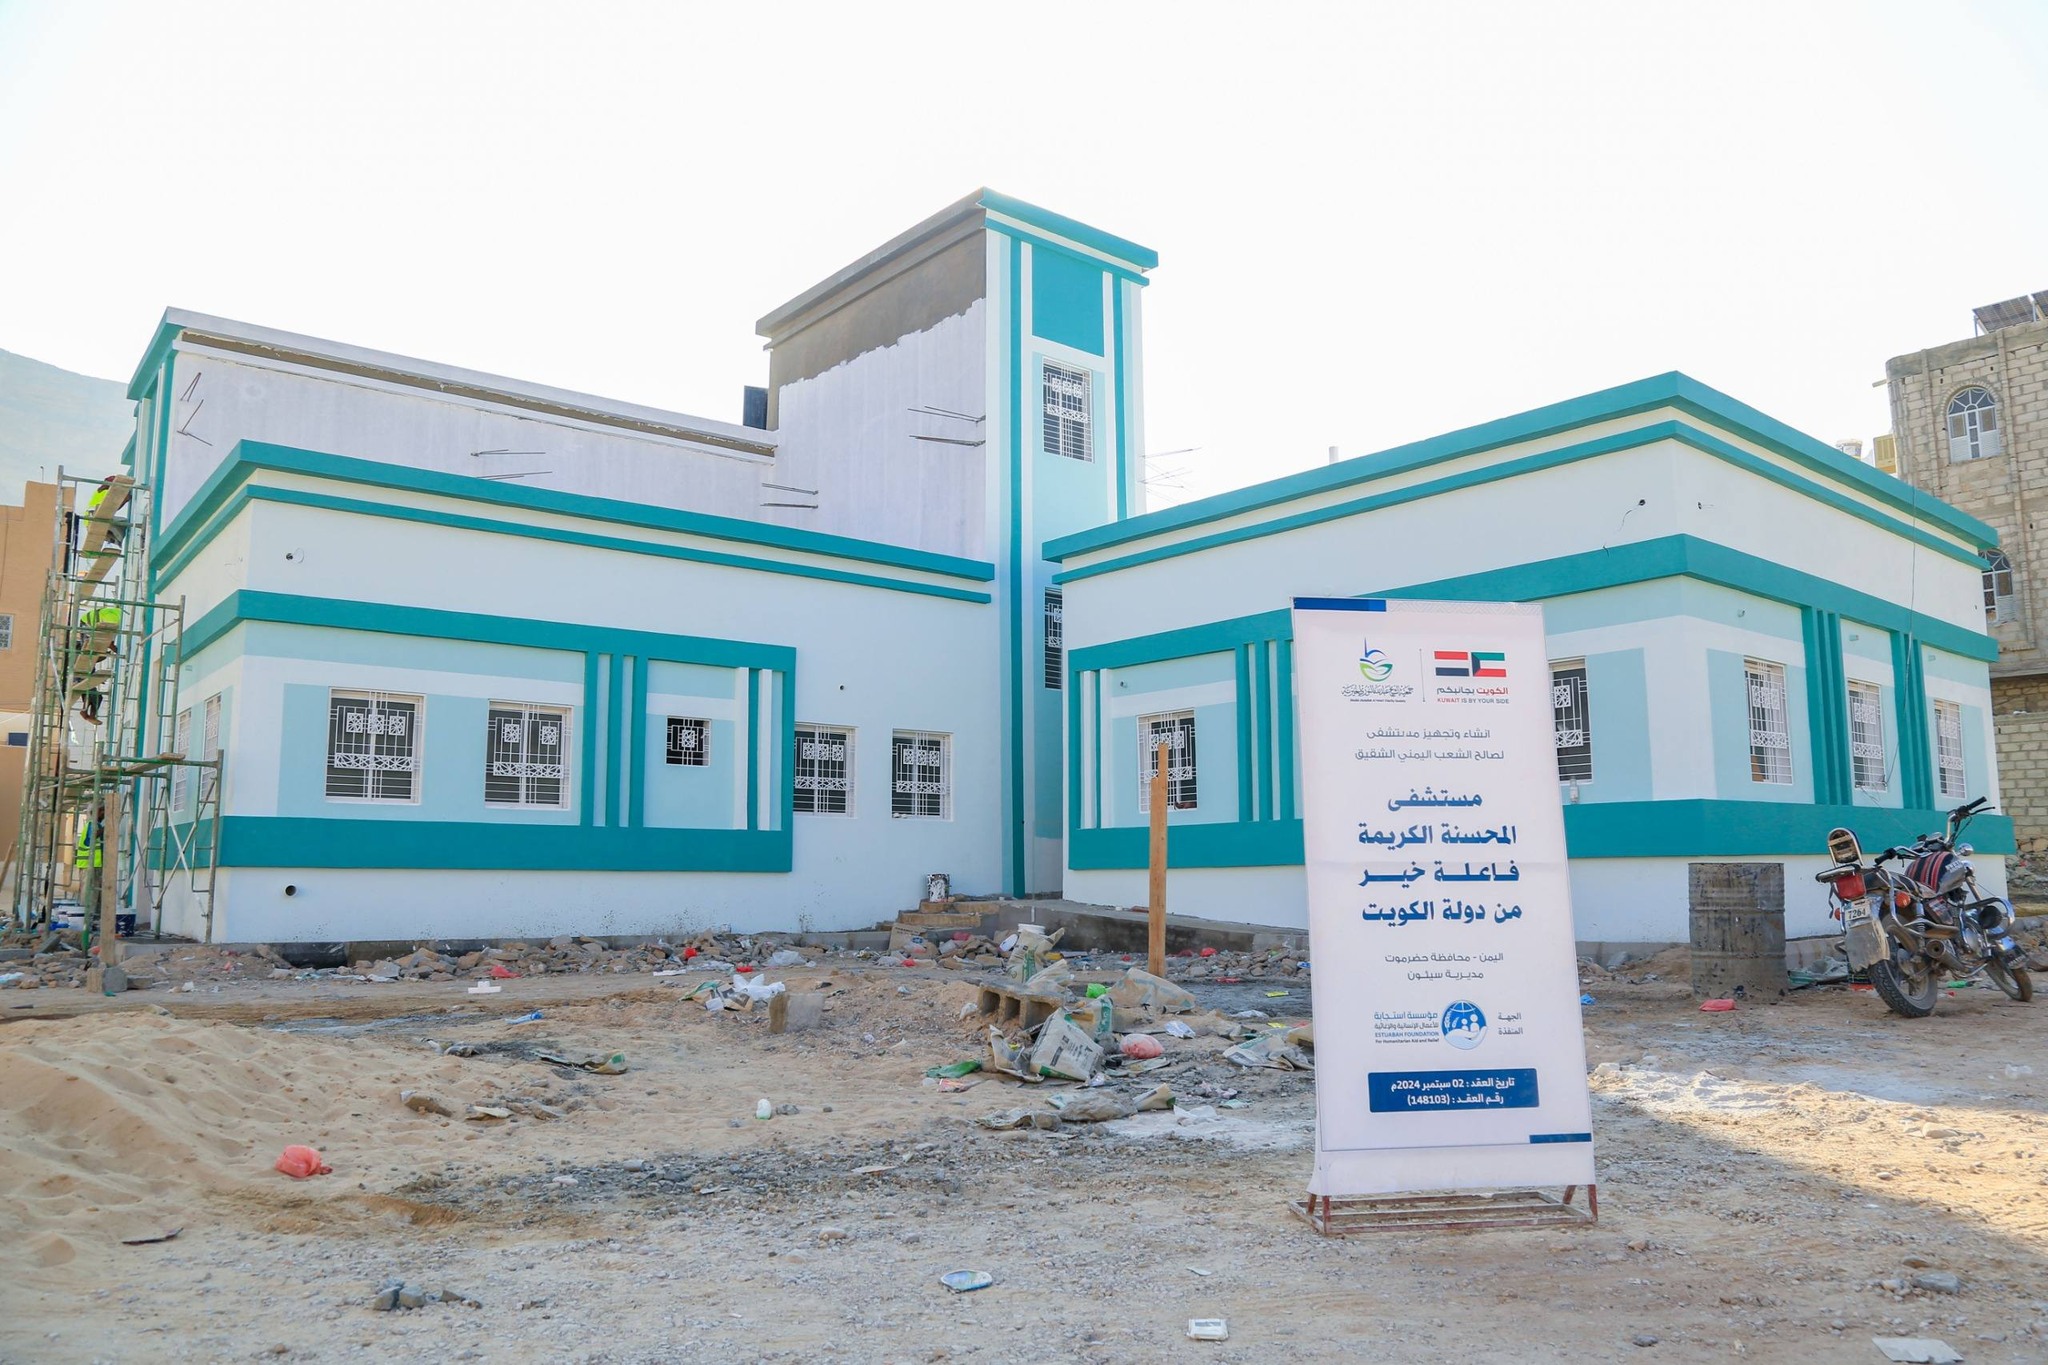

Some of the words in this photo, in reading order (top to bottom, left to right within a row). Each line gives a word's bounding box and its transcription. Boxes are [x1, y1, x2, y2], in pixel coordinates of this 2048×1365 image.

[1436, 686, 1475, 695] بجانبكم
[1476, 687, 1509, 696] الكويت
[1366, 727, 1420, 739] مستشفى
[1423, 729, 1461, 740] وتجهيز
[1463, 728, 1490, 739] انشاء
[1355, 748, 1395, 761] الشقيق
[1398, 749, 1432, 763] اليمني
[1434, 748, 1472, 761] الشعب
[1474, 749, 1504, 761] لصالح
[1388, 786, 1483, 812] مستشفى
[1358, 822, 1433, 850] الكريمة
[1441, 823, 1517, 845] المحسنة
[1358, 861, 1426, 888] خير
[1434, 860, 1520, 882] فاعلة
[1362, 901, 1435, 927] الكويت
[1442, 898, 1486, 924] دولة
[1494, 903, 1523, 923] من
[1385, 954, 1429, 963] حضرموت
[1430, 953, 1471, 962] محافظة
[1479, 952, 1504, 962] اليمن
[1407, 971, 1443, 981] سيئون
[1445, 970, 1484, 980] مديرية
[1374, 1011, 1406, 1020] استجابة
[1407, 1011, 1438, 1021] مؤسسة
[1498, 1012, 1522, 1022] الجهة
[1498, 1027, 1523, 1036] المنفذة
[1422, 1079, 1450, 1091] سبتمبر
[1452, 1079, 1465, 1088] 02
[1471, 1077, 1494, 1088] العقد
[1496, 1076, 1515, 1089] تاريخ
[1407, 1095, 1450, 1105] (148103)
[1457, 1094, 1484, 1103] العقد
[1486, 1093, 1504, 1105] رقم
